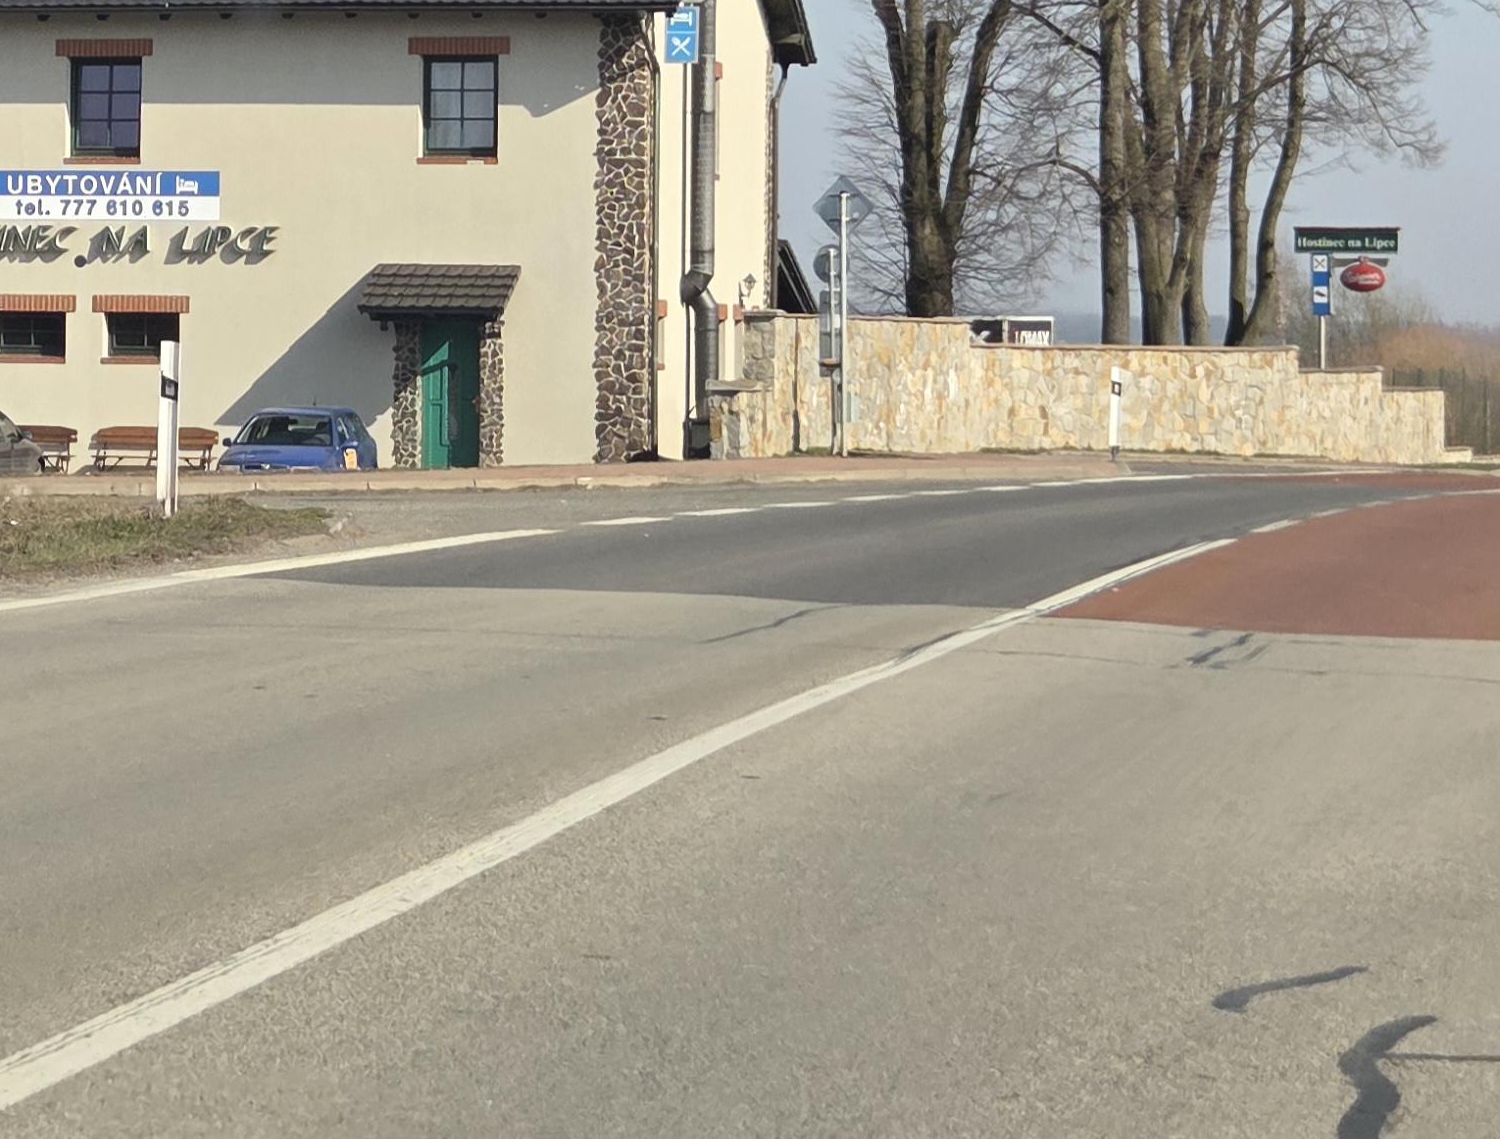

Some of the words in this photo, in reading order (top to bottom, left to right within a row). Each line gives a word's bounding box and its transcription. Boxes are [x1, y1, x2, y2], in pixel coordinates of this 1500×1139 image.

[7, 172, 163, 195] UBYTOVÁNÍ
[15, 199, 50, 216] tel.
[60, 199, 97, 216] 777
[106, 199, 143, 216] 610
[152, 199, 190, 216] 615
[93, 225, 149, 260] NA
[171, 226, 280, 261] LIPCE
[1298, 237, 1345, 248] Hostinec
[1348, 239, 1362, 248] na
[1365, 237, 1396, 250] Lipce
